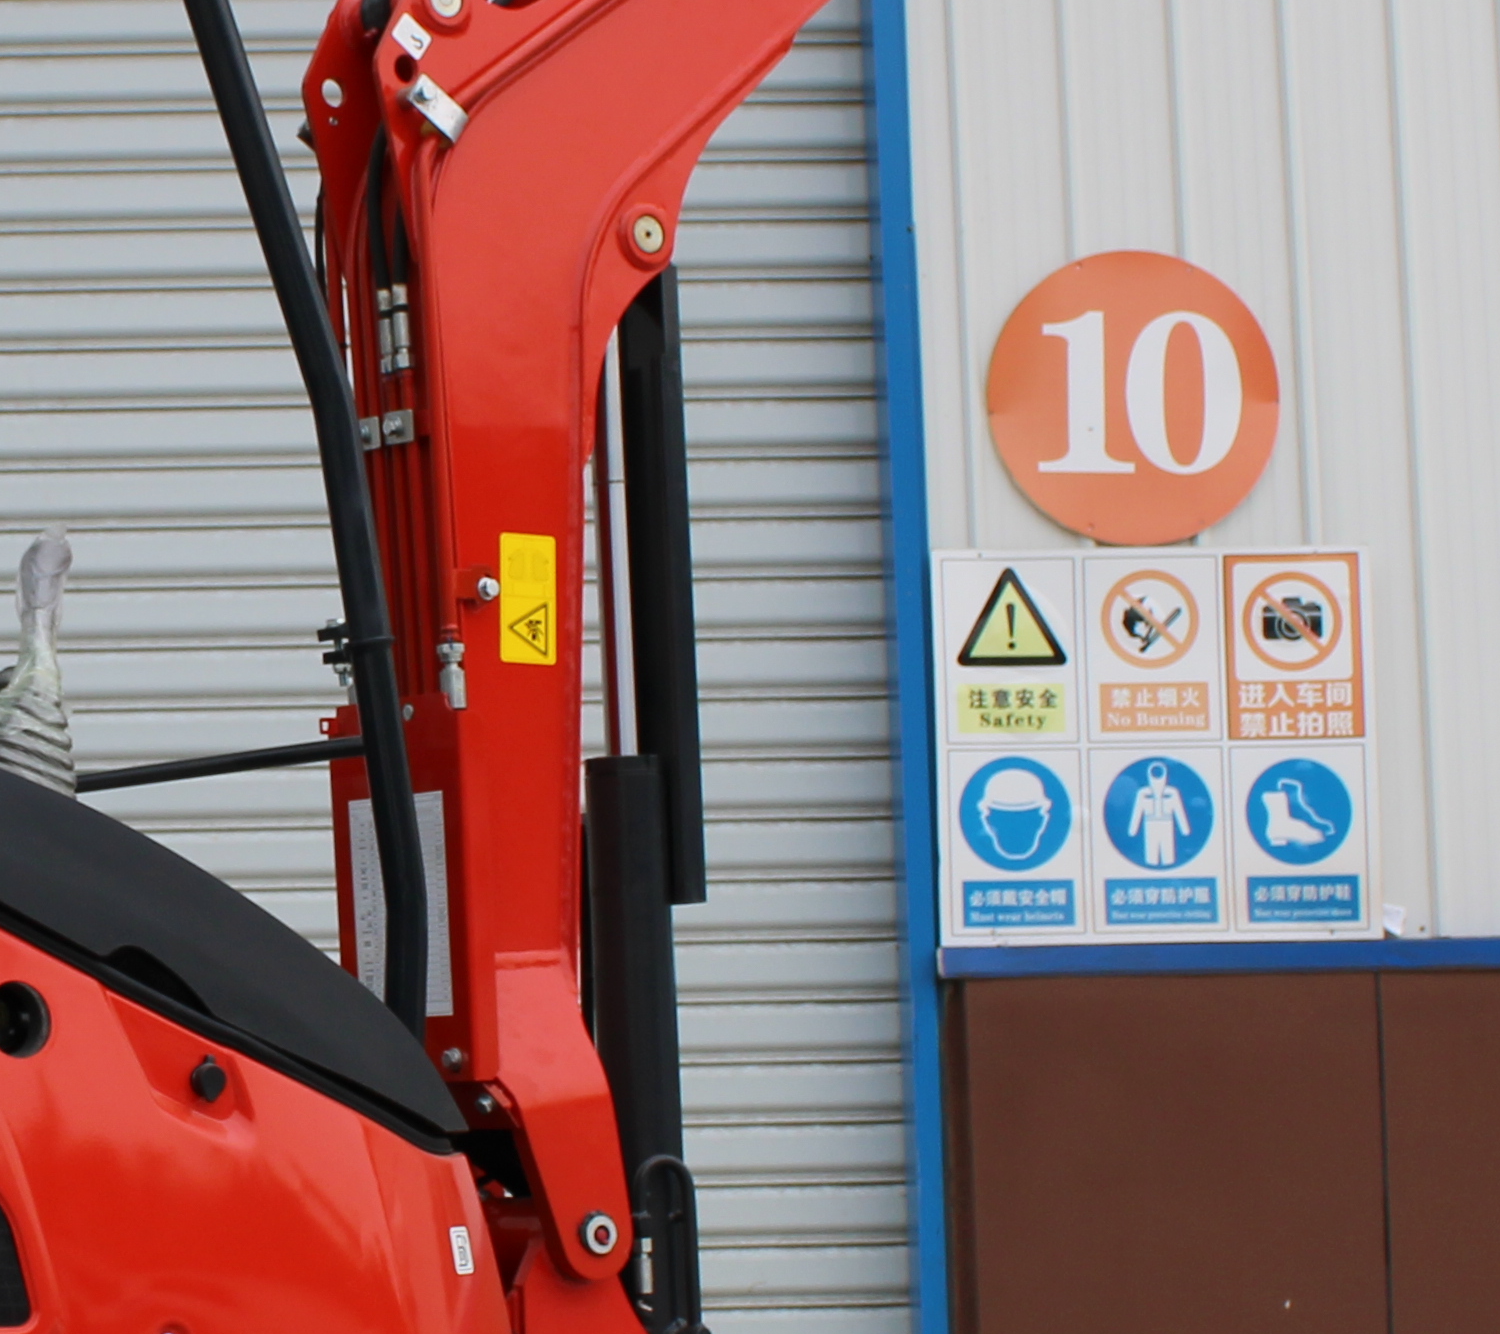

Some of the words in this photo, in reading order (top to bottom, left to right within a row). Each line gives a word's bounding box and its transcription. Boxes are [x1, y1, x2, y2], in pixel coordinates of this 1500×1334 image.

[1037, 310, 1243, 475] 10
[969, 687, 1058, 709] 注意安全
[1111, 687, 1200, 708] 禁止烟火
[1238, 681, 1353, 709] 进入车间
[979, 712, 1046, 730] Safety
[1107, 710, 1131, 727] No
[1136, 709, 1206, 728] Burning
[1239, 711, 1354, 738] 禁止拍照
[970, 888, 1067, 907] 必须戴安全帽
[1111, 886, 1211, 905] 必须穿防护服
[1254, 884, 1352, 903] 必须穿防护鞋
